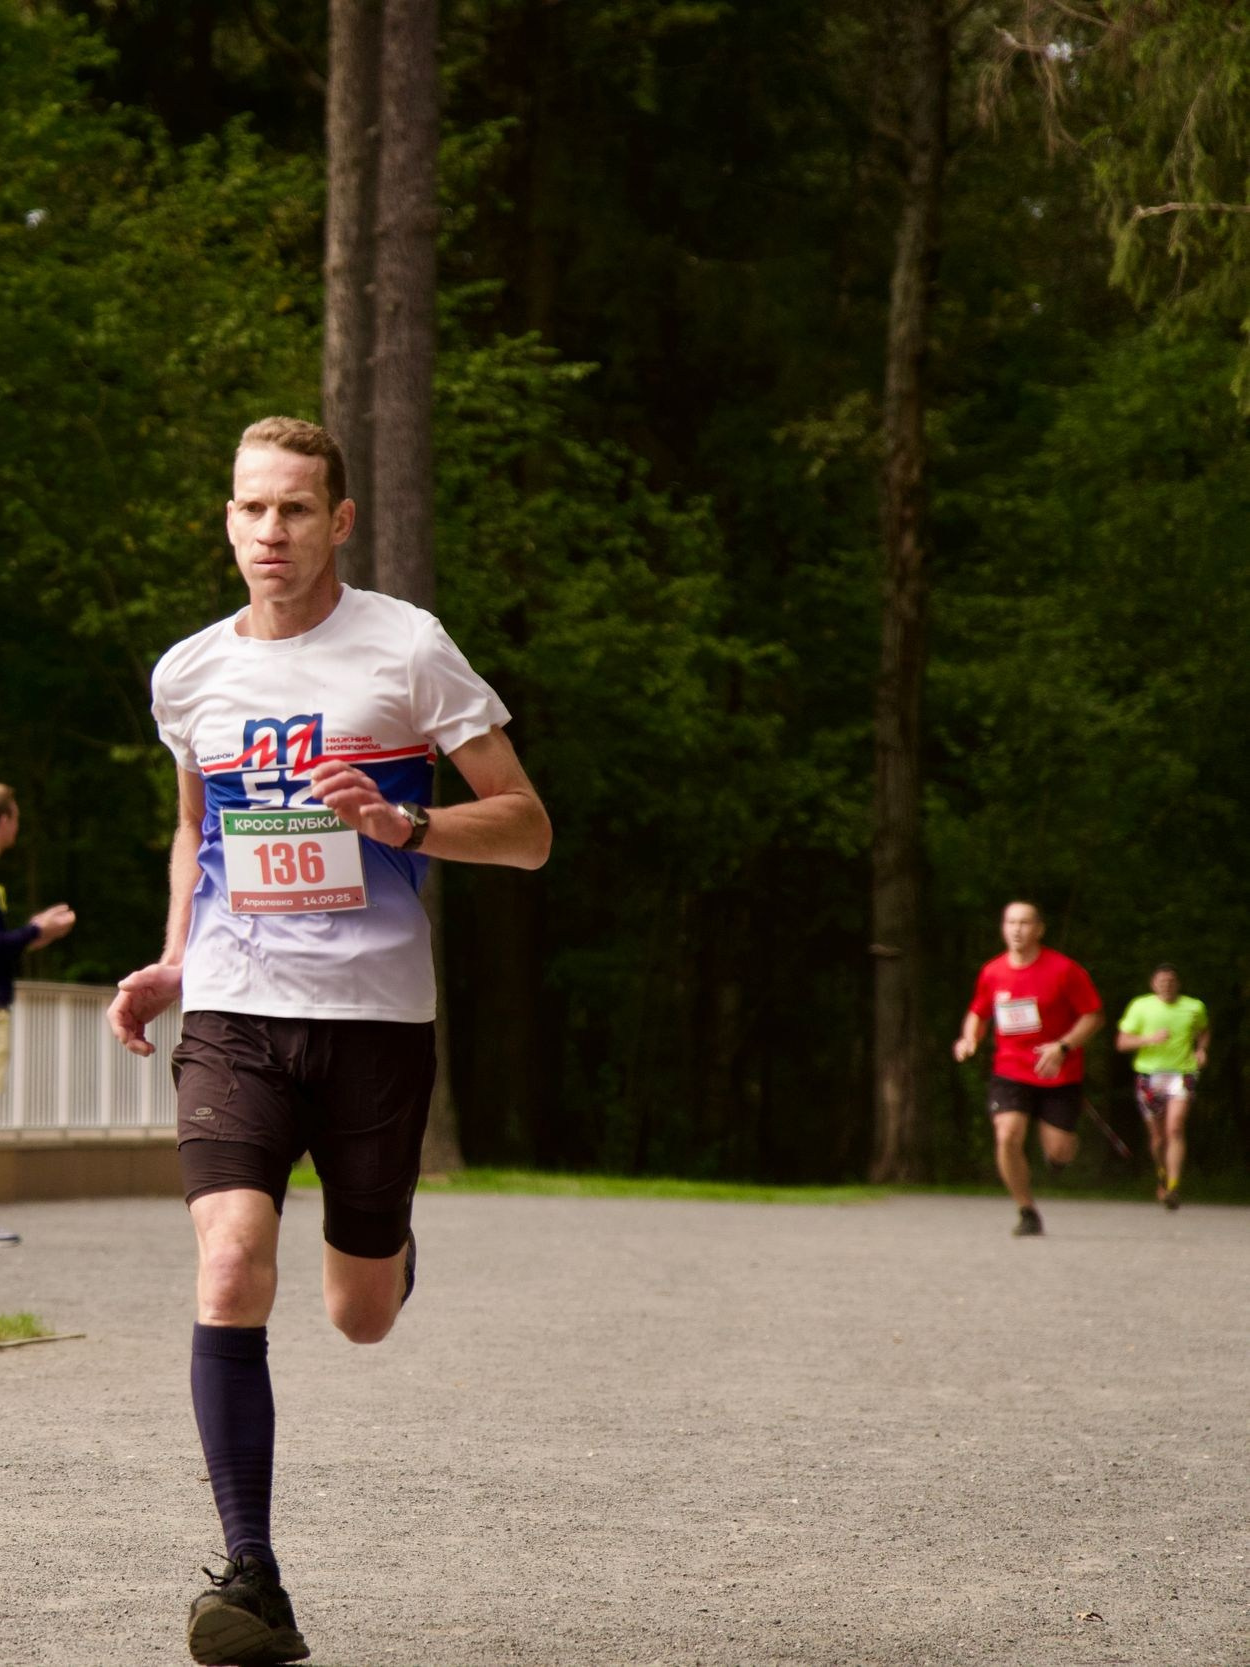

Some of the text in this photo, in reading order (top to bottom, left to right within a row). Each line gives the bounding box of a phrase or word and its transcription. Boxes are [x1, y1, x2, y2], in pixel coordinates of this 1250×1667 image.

[234, 816, 340, 832] КРОСС ДУБКИ
[253, 841, 325, 885] 136
[303, 893, 351, 906] 14.09.25
